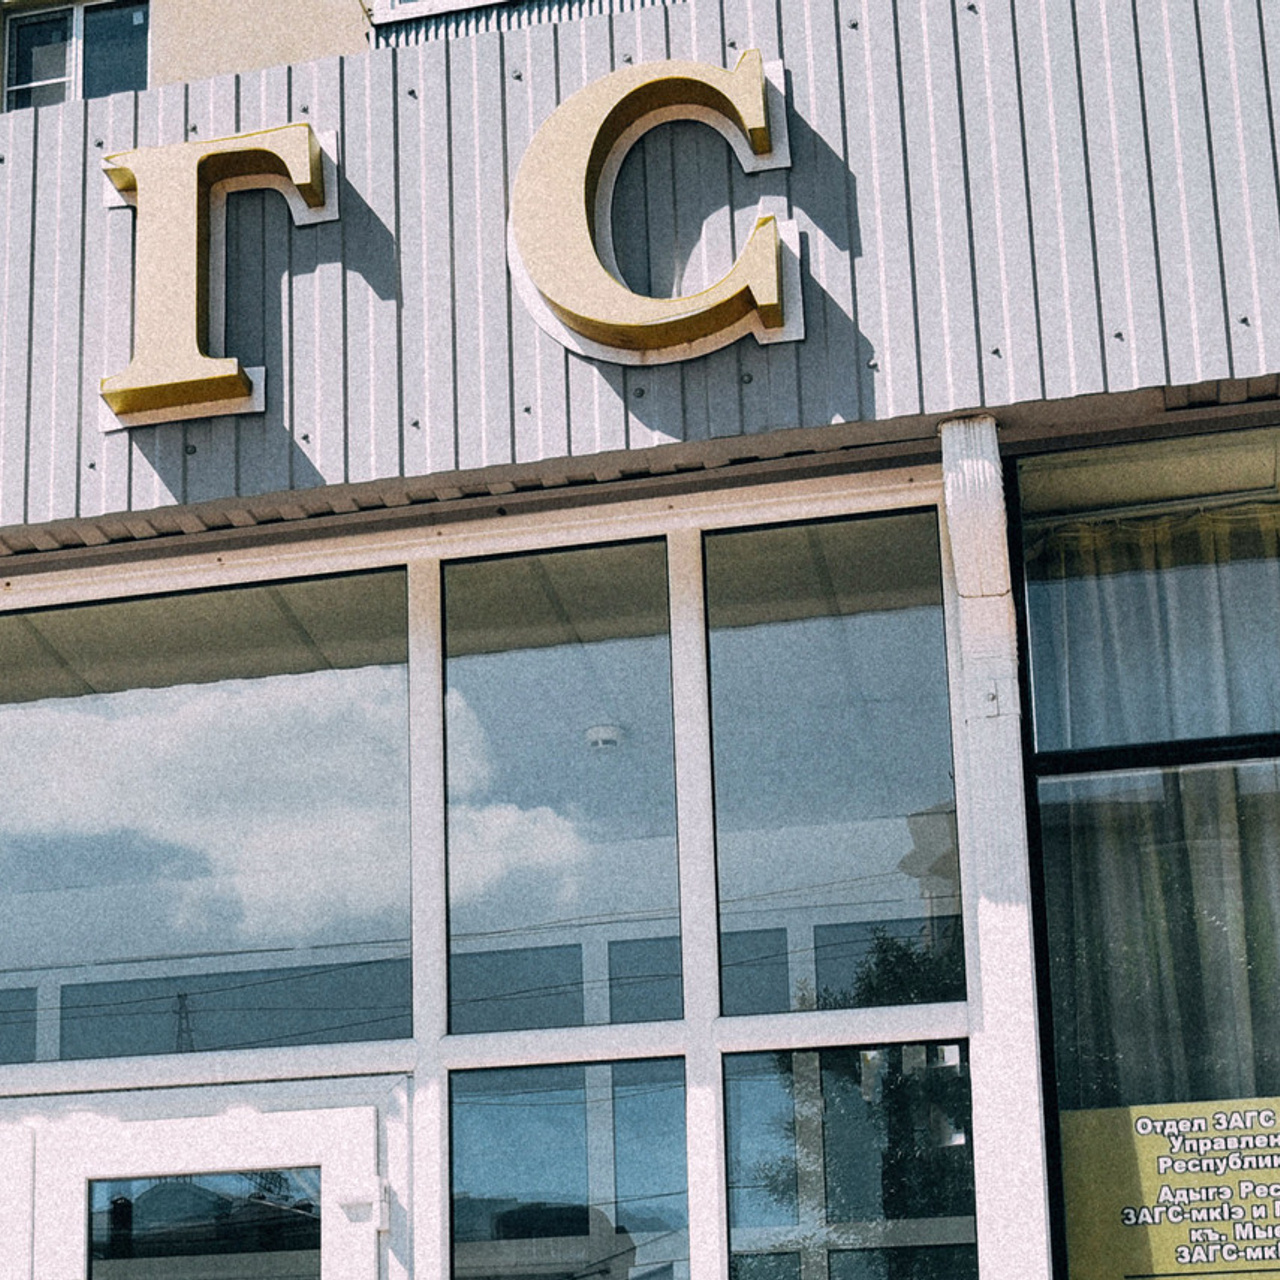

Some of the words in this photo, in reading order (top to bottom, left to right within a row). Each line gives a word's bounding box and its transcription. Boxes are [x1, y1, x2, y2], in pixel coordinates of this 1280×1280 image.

[1136, 1116, 1207, 1135] Отдел
[1212, 1109, 1276, 1130] ЗАГС
[1170, 1133, 1280, 1155] Управлен
[1158, 1184, 1233, 1205] Адыгэ
[1251, 1204, 1268, 1219] и
[1189, 1227, 1228, 1244] къ.
